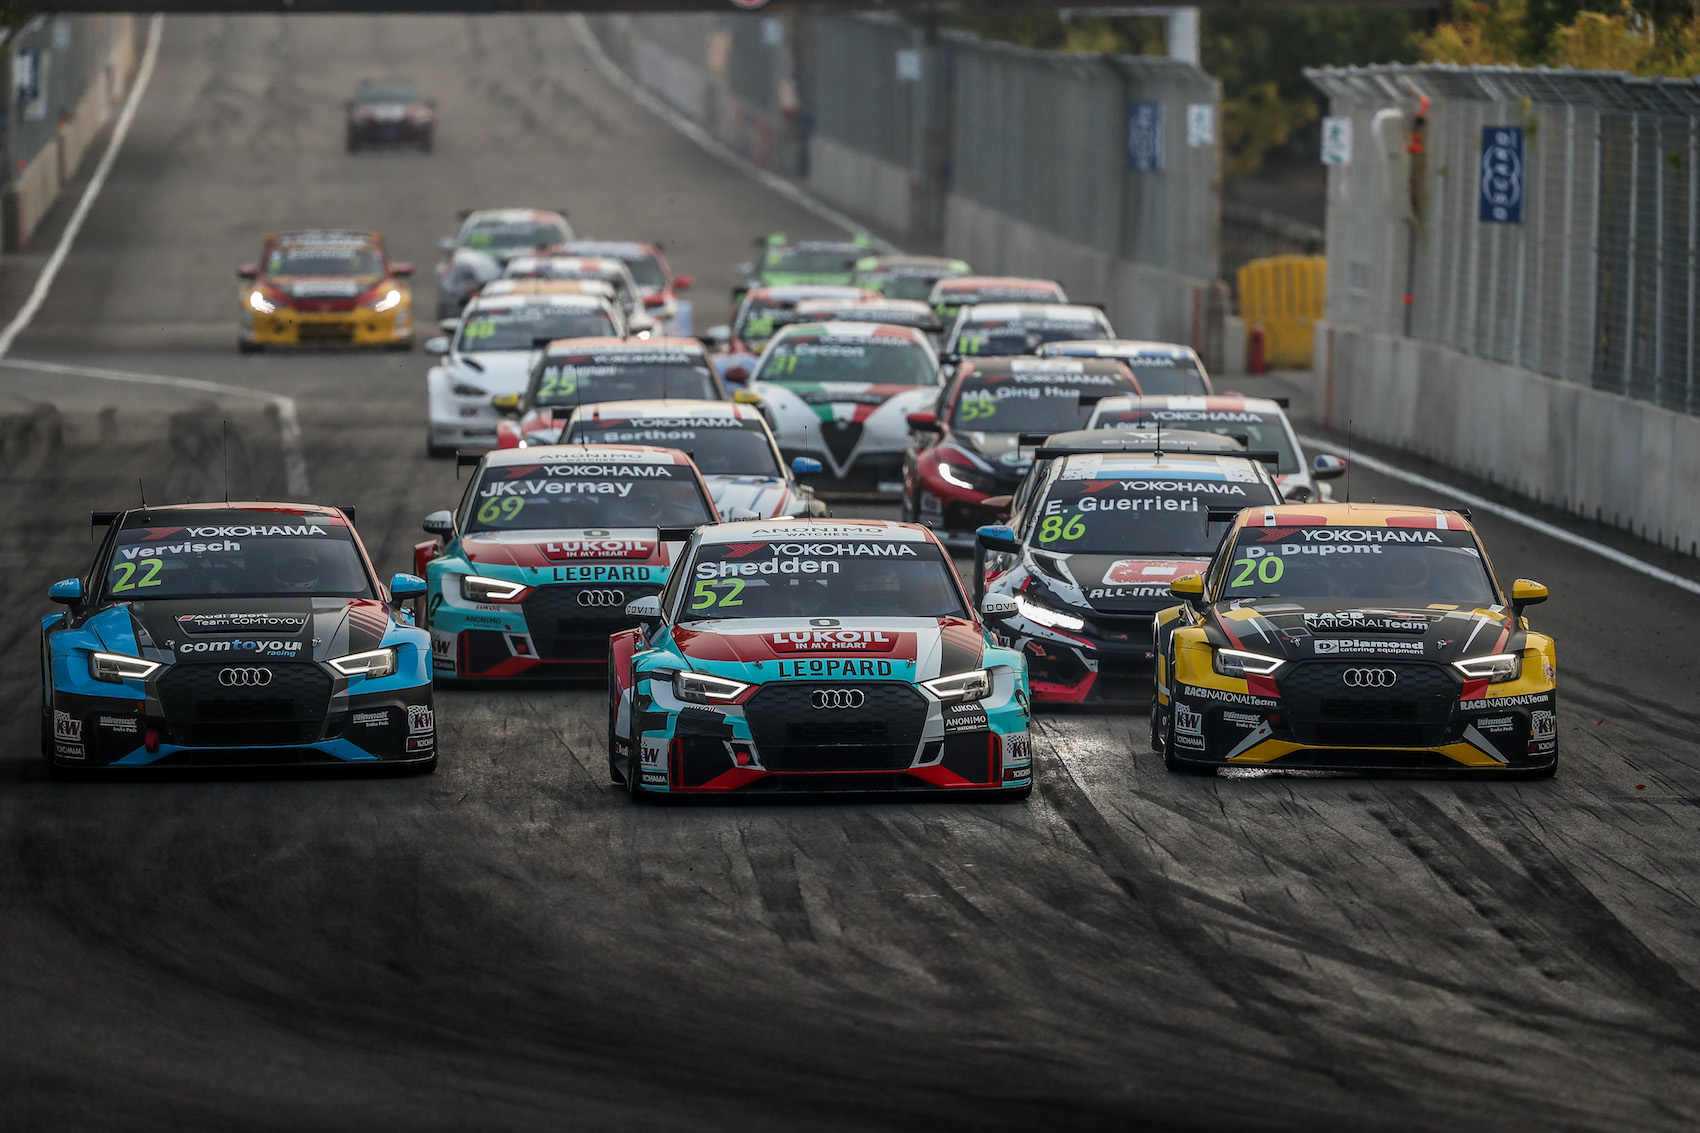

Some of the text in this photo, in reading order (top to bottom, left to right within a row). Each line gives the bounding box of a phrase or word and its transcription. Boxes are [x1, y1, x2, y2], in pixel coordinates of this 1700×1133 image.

[1013, 374, 1114, 385] YOKOHAMA
[537, 376, 576, 397] 25
[962, 398, 996, 421] 55
[629, 418, 743, 428] YOKOHAMA
[1150, 411, 1264, 423] YOKOHAMA
[604, 430, 696, 442] Berthon
[543, 465, 672, 477] YOKOHAMA
[480, 479, 633, 497] JK.Vernay
[1119, 481, 1247, 497] YOKOHAMA
[477, 496, 525, 523] 69
[1045, 496, 1199, 516] E. Guerrieri
[186, 525, 327, 538] YOKOHAMA
[752, 527, 883, 535] ANONIMO
[1038, 514, 1087, 543] 86
[1301, 529, 1443, 543] YOKOHAMA
[121, 539, 241, 560] Vervisch
[547, 541, 648, 552] LUKOIL
[769, 543, 918, 556] YOKOHAMA
[1246, 543, 1382, 559] D. Dupont
[553, 566, 650, 582] LEOPARD
[696, 557, 840, 580] Shedden
[1230, 556, 1284, 589] 20
[113, 559, 163, 593] 22
[692, 578, 745, 610] 52
[1089, 587, 1171, 598] ALL-INK
[987, 602, 1016, 612] DOVIT
[232, 617, 304, 625] COMTOYOU
[465, 615, 501, 624] ANONIMO
[1304, 612, 1364, 620] RACB
[773, 631, 889, 644] LUKOIL
[180, 640, 299, 653] comtoyou
[1340, 639, 1424, 650] Diamond
[267, 650, 296, 658] racing
[778, 660, 892, 678] LEOPARD
[951, 704, 981, 713] LUKOIL
[946, 715, 987, 728] ANONIMO
